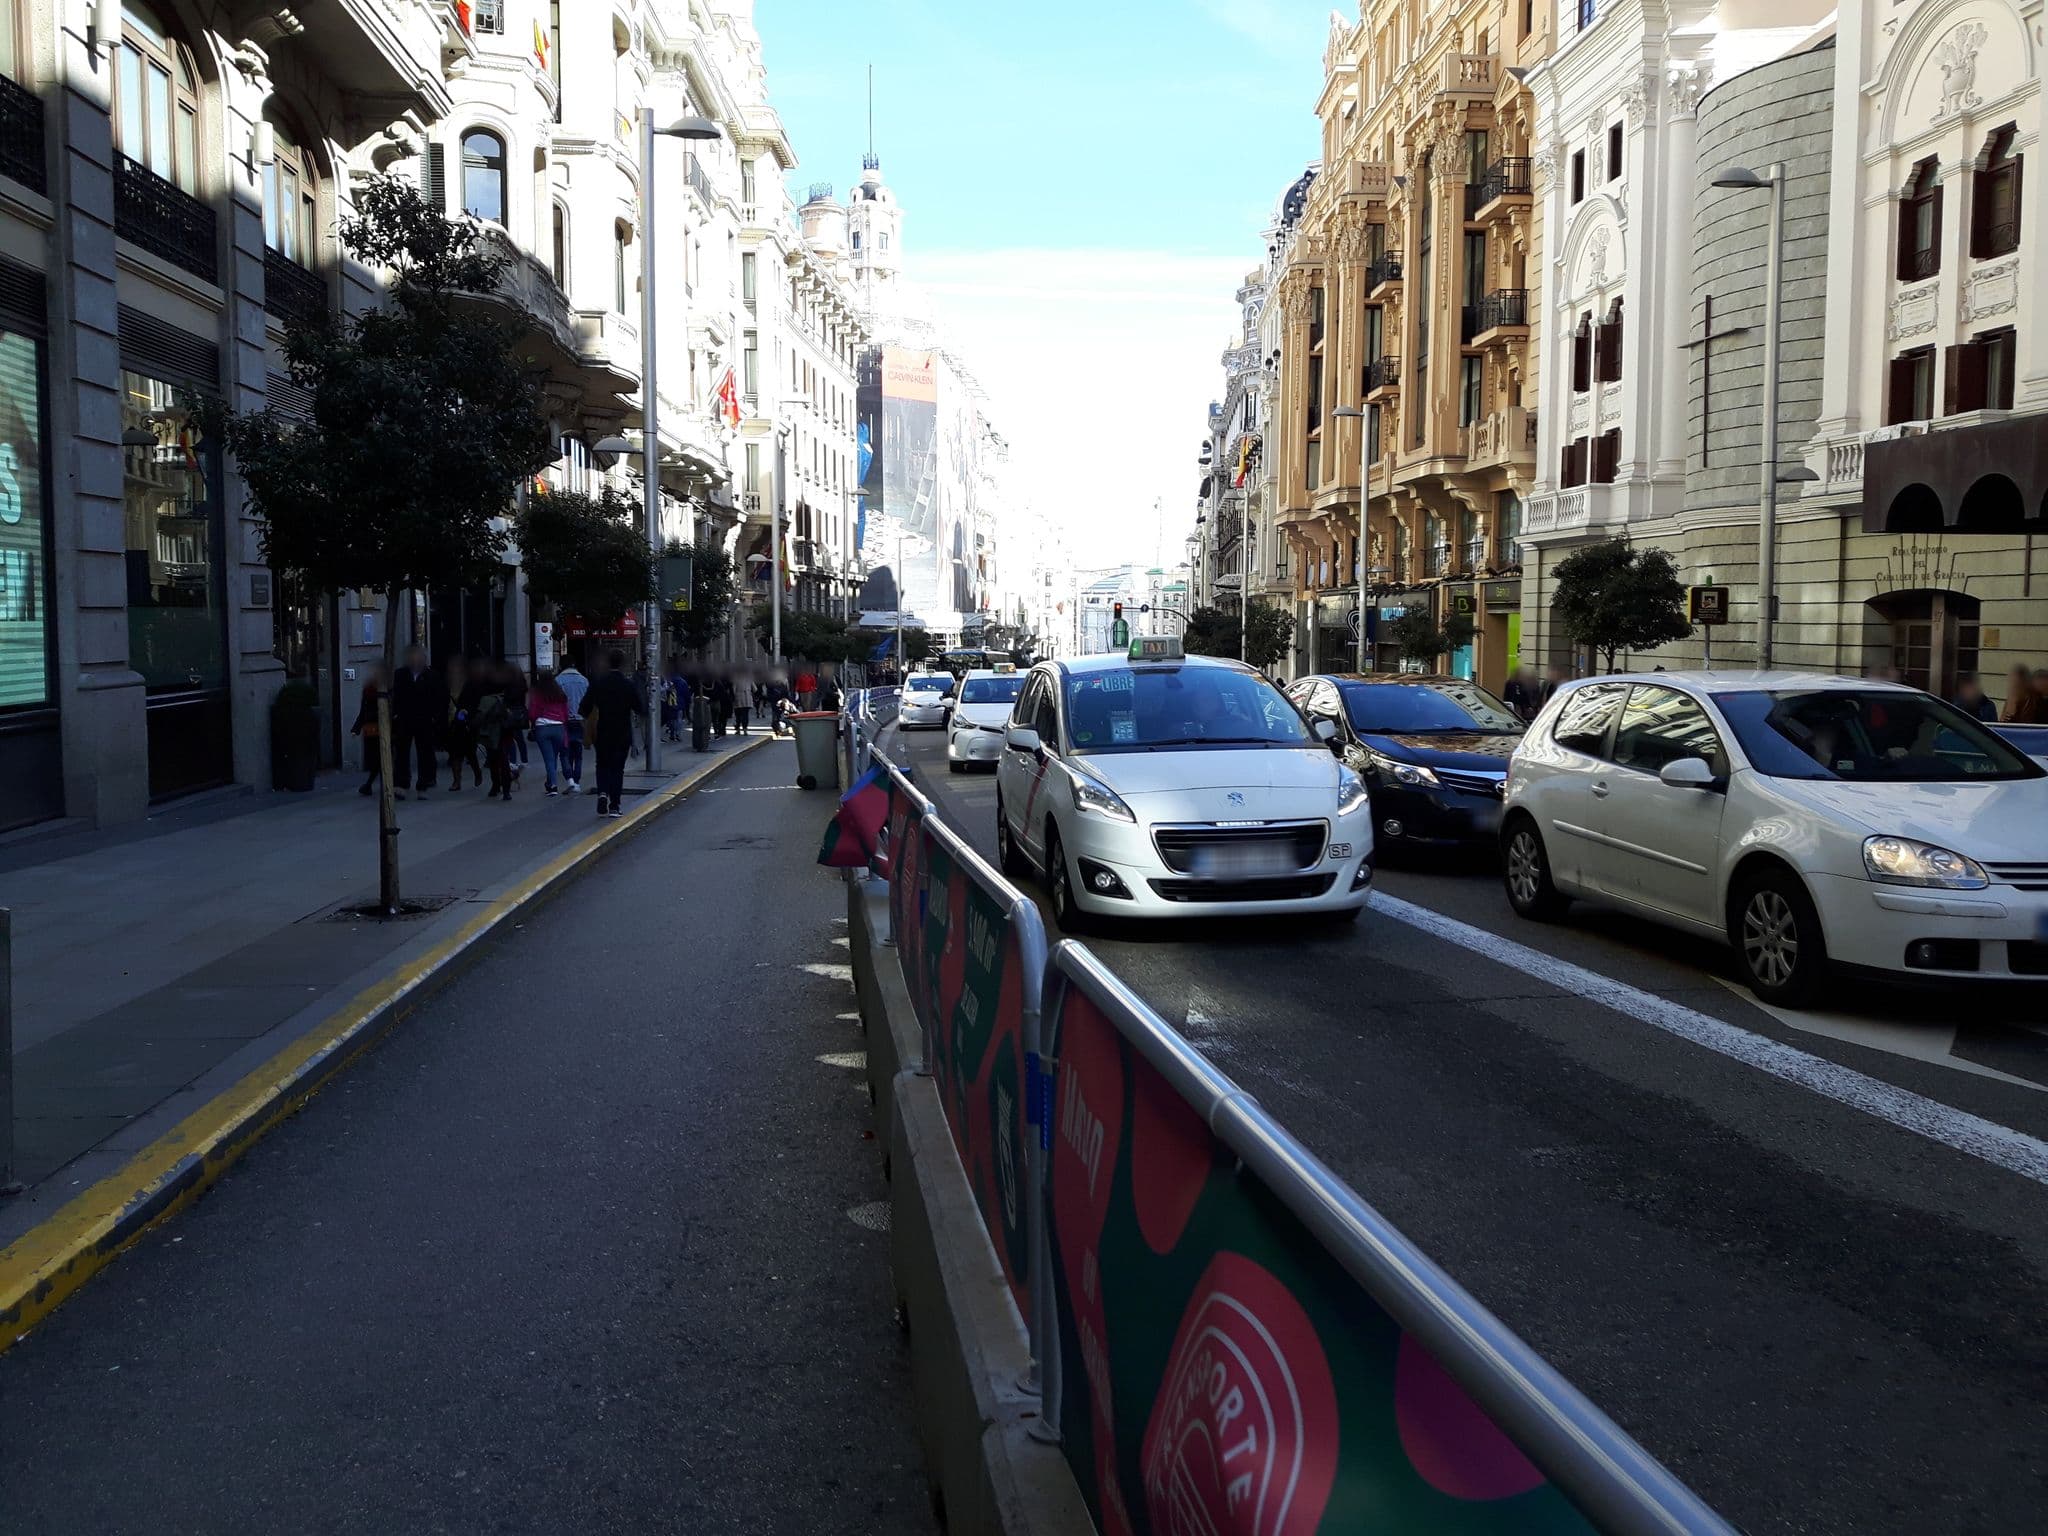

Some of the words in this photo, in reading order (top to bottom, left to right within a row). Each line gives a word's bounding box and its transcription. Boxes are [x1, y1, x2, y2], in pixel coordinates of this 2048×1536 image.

[888, 370, 914, 383] CALVIN
[914, 373, 933, 385] KLEIN
[1143, 641, 1167, 654] TAXI
[1103, 675, 1135, 692] LIBRE
[1331, 845, 1349, 857] SP
